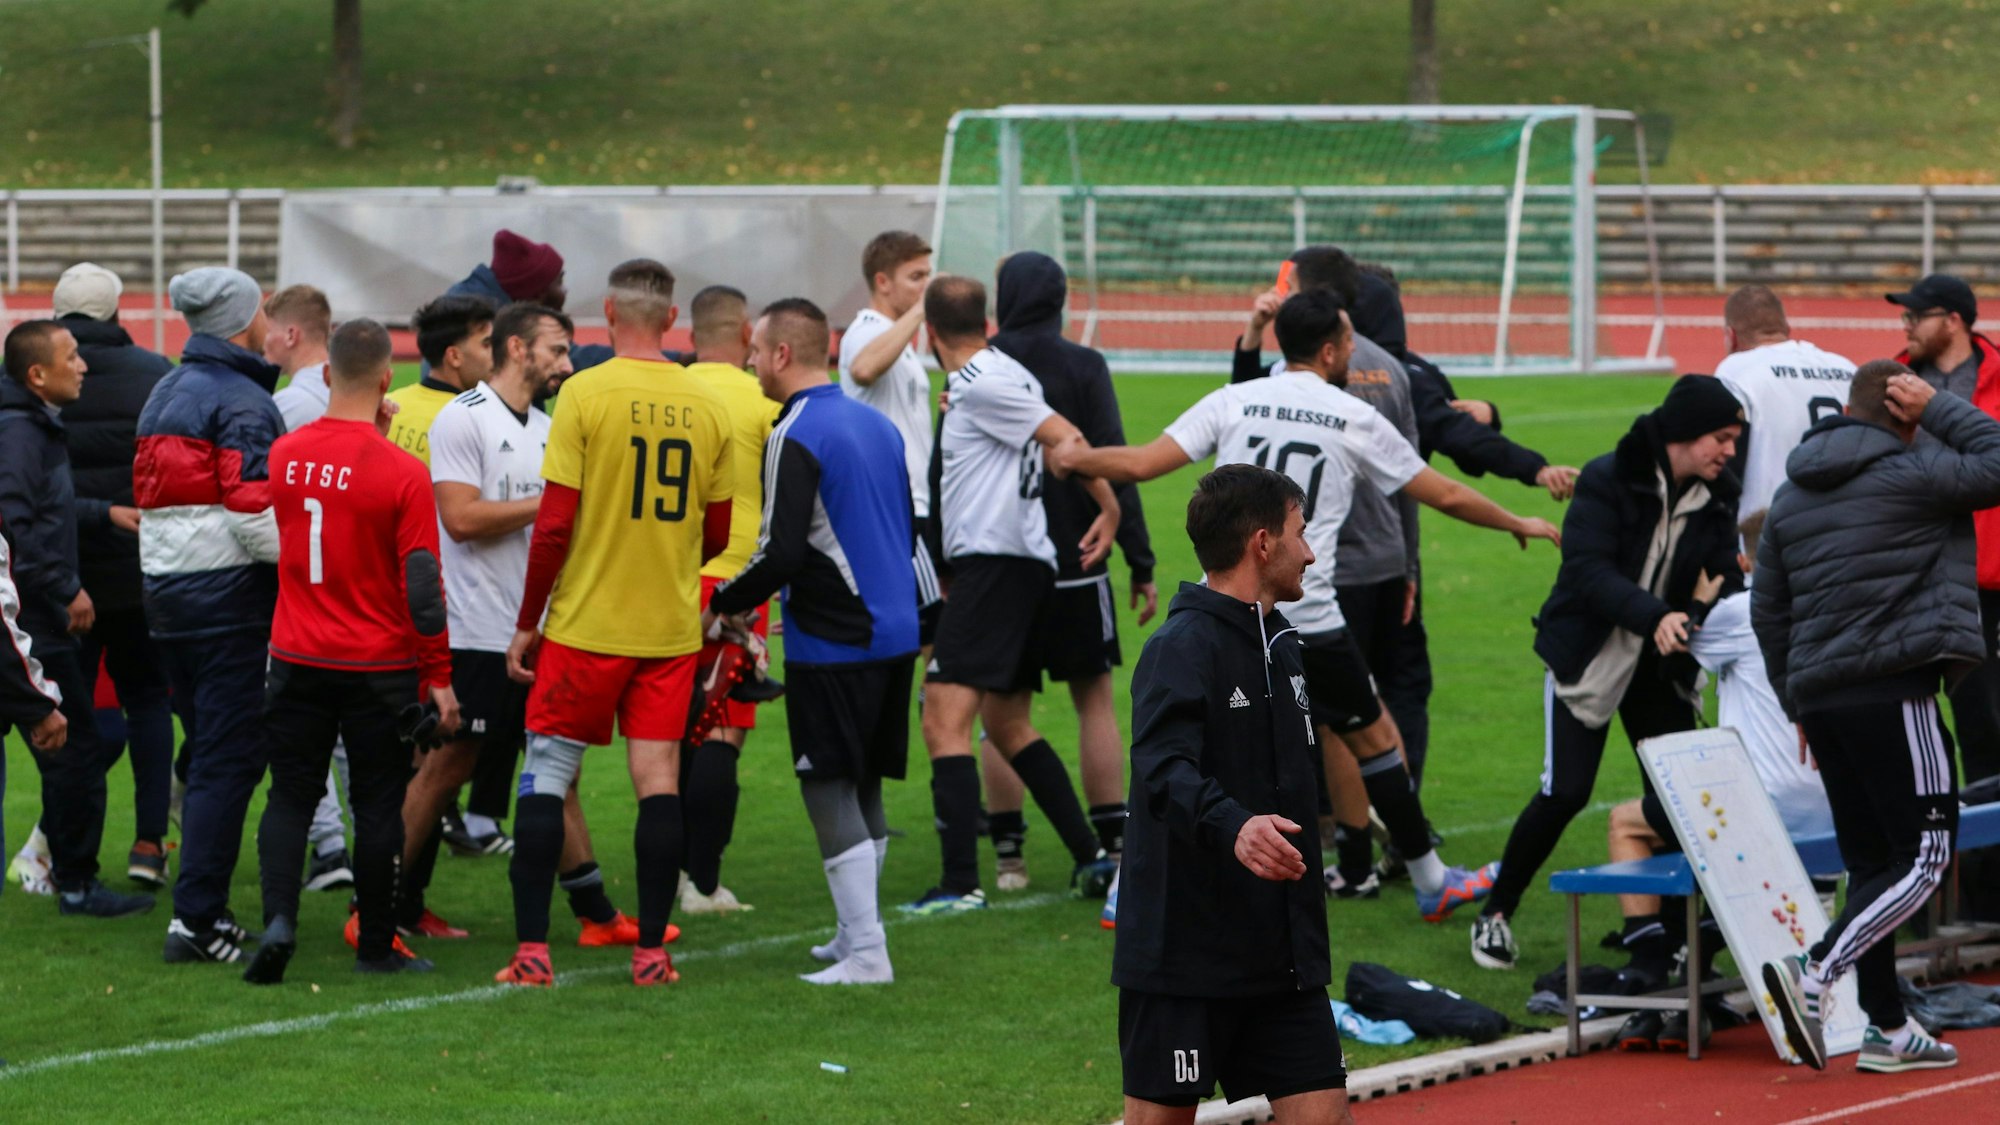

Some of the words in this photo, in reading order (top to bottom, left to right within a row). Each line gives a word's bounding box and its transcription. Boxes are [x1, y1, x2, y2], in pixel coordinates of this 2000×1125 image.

[631, 401, 692, 430] ETSC
[1243, 405, 1271, 418] VFB
[1276, 406, 1348, 432] BLESSEM
[394, 425, 429, 453] TSC
[285, 460, 352, 491] ETSC
[631, 436, 693, 523] 19
[303, 497, 324, 585] 1
[1173, 1049, 1200, 1083] DJ
